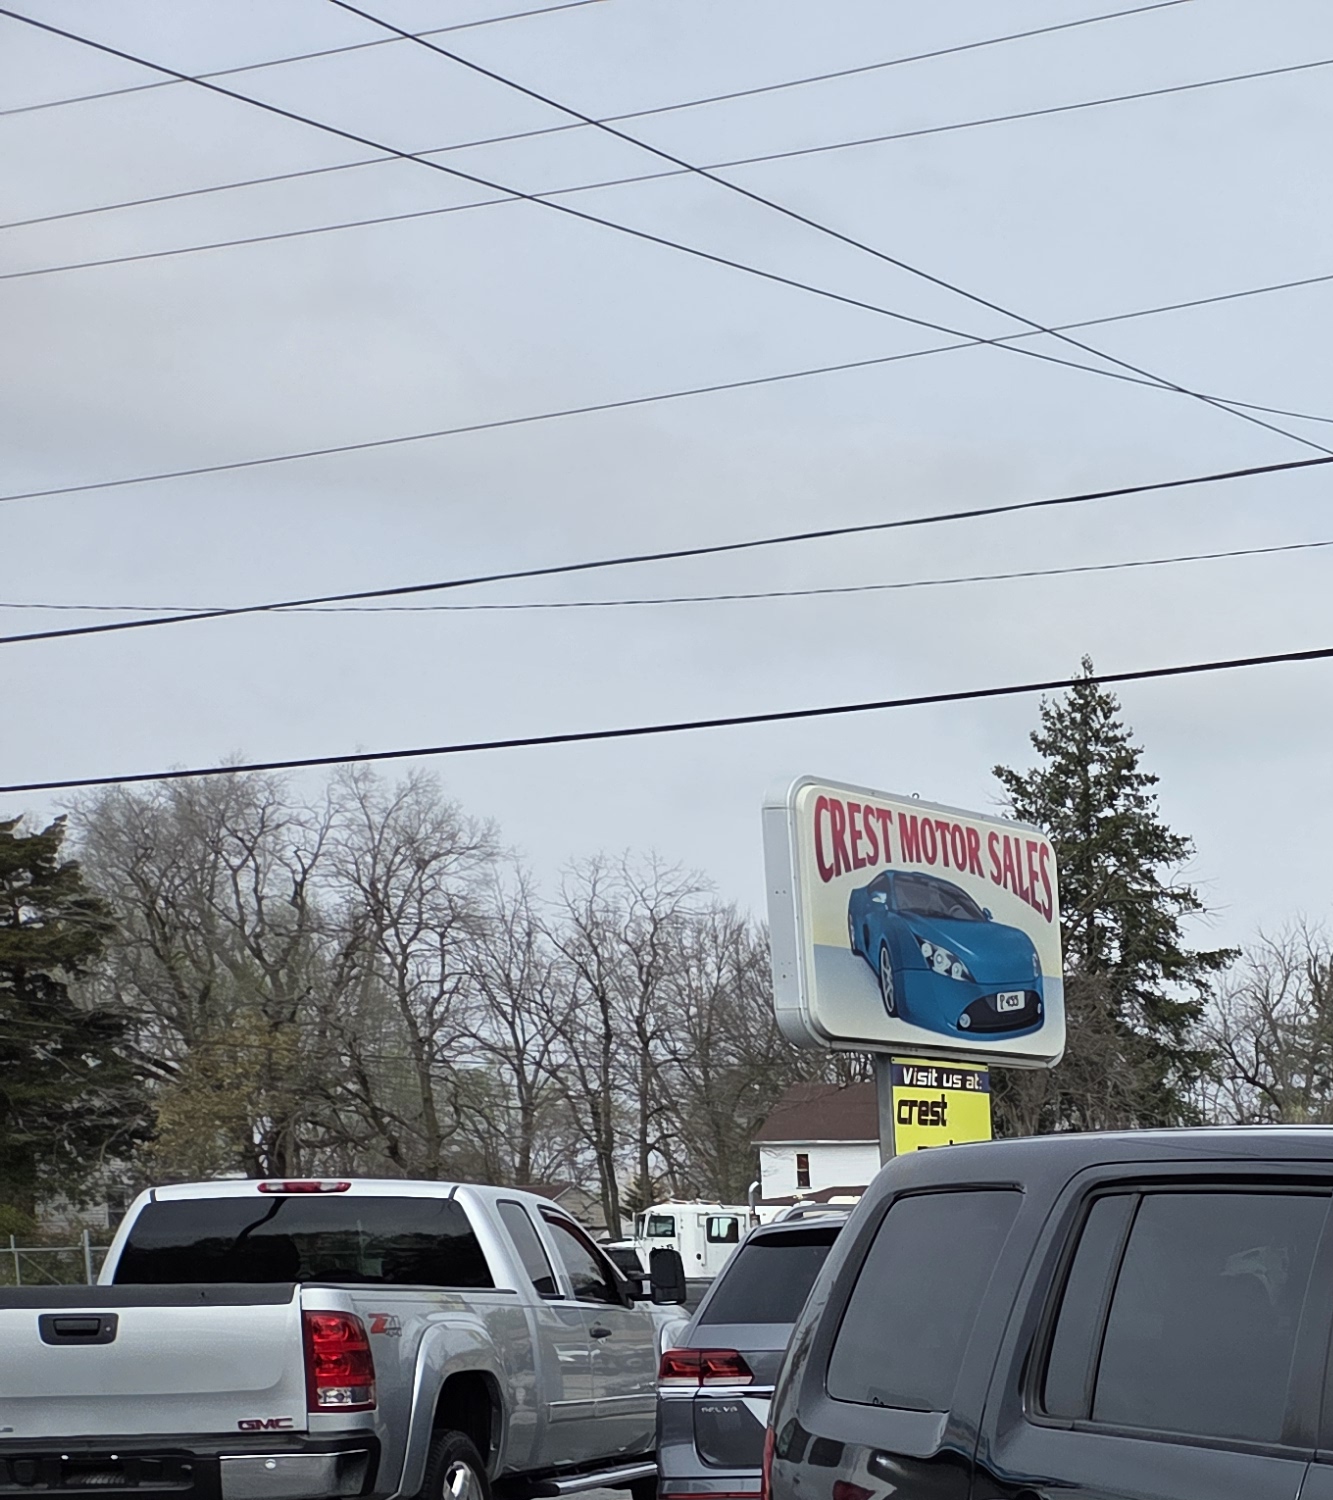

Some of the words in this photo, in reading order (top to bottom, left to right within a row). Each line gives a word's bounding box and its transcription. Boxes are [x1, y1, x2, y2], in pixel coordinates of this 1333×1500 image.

[814, 795, 893, 883] CREST
[898, 812, 985, 878] MOTOR
[988, 831, 1053, 923] SALES
[903, 1066, 938, 1086] Visit
[943, 1073, 962, 1088] us
[897, 1094, 947, 1127] crest
[238, 1418, 293, 1430] GMC
